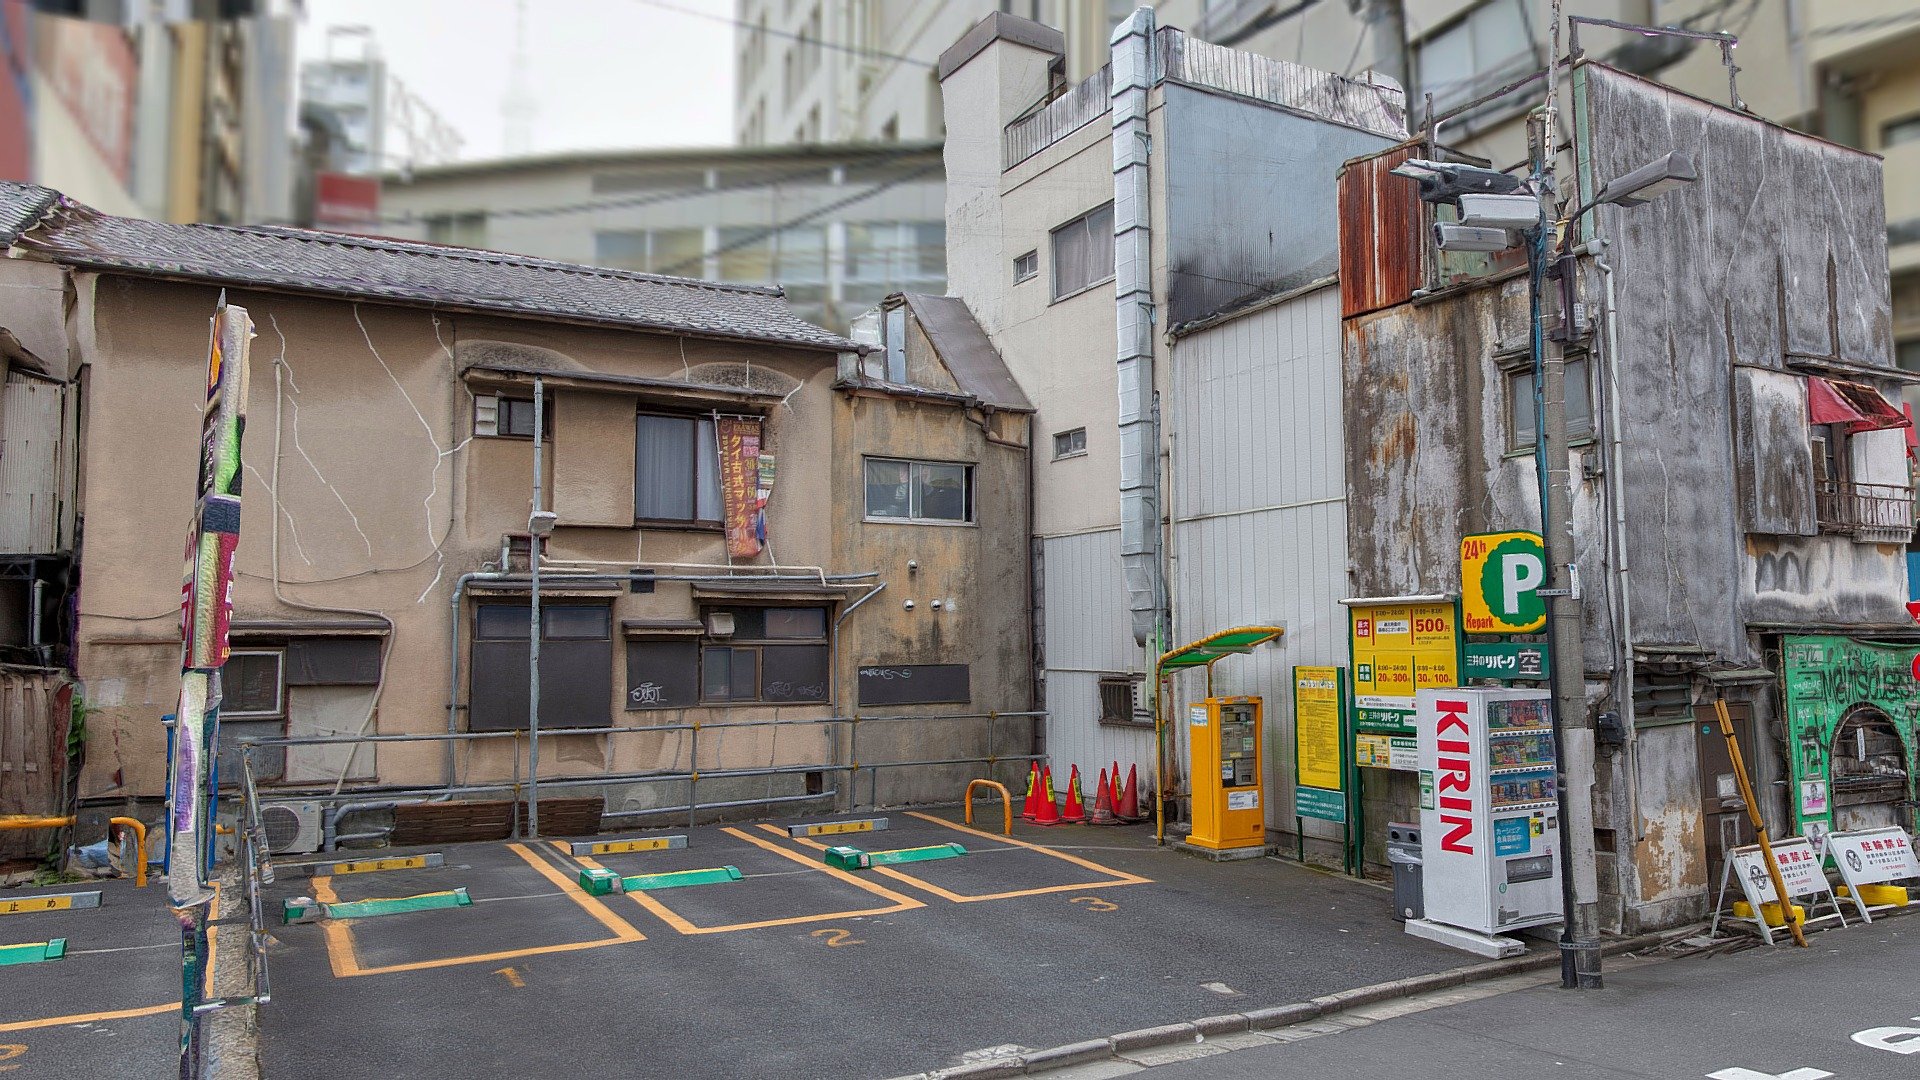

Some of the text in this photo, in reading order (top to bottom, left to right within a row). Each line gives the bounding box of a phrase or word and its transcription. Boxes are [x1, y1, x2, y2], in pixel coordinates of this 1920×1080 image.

[722, 435, 730, 473] MASSAGE
[1463, 540, 1486, 560] 24h
[1502, 553, 1543, 614] P
[1415, 618, 1450, 633] 500円
[1466, 612, 1494, 630] Repark
[1467, 654, 1516, 669] 三井のリパーク
[1518, 648, 1541, 674] 空
[1368, 711, 1400, 722] 三井のリパーク
[1436, 700, 1474, 856] KIRIN
[817, 821, 865, 833] 車止め
[603, 840, 660, 852] 車止め
[1860, 837, 1906, 852] 駐輪禁止
[347, 859, 414, 872] 車止め
[1778, 849, 1813, 865] 輪禁止
[810, 928, 867, 947] 2
[494, 967, 526, 988] 1
